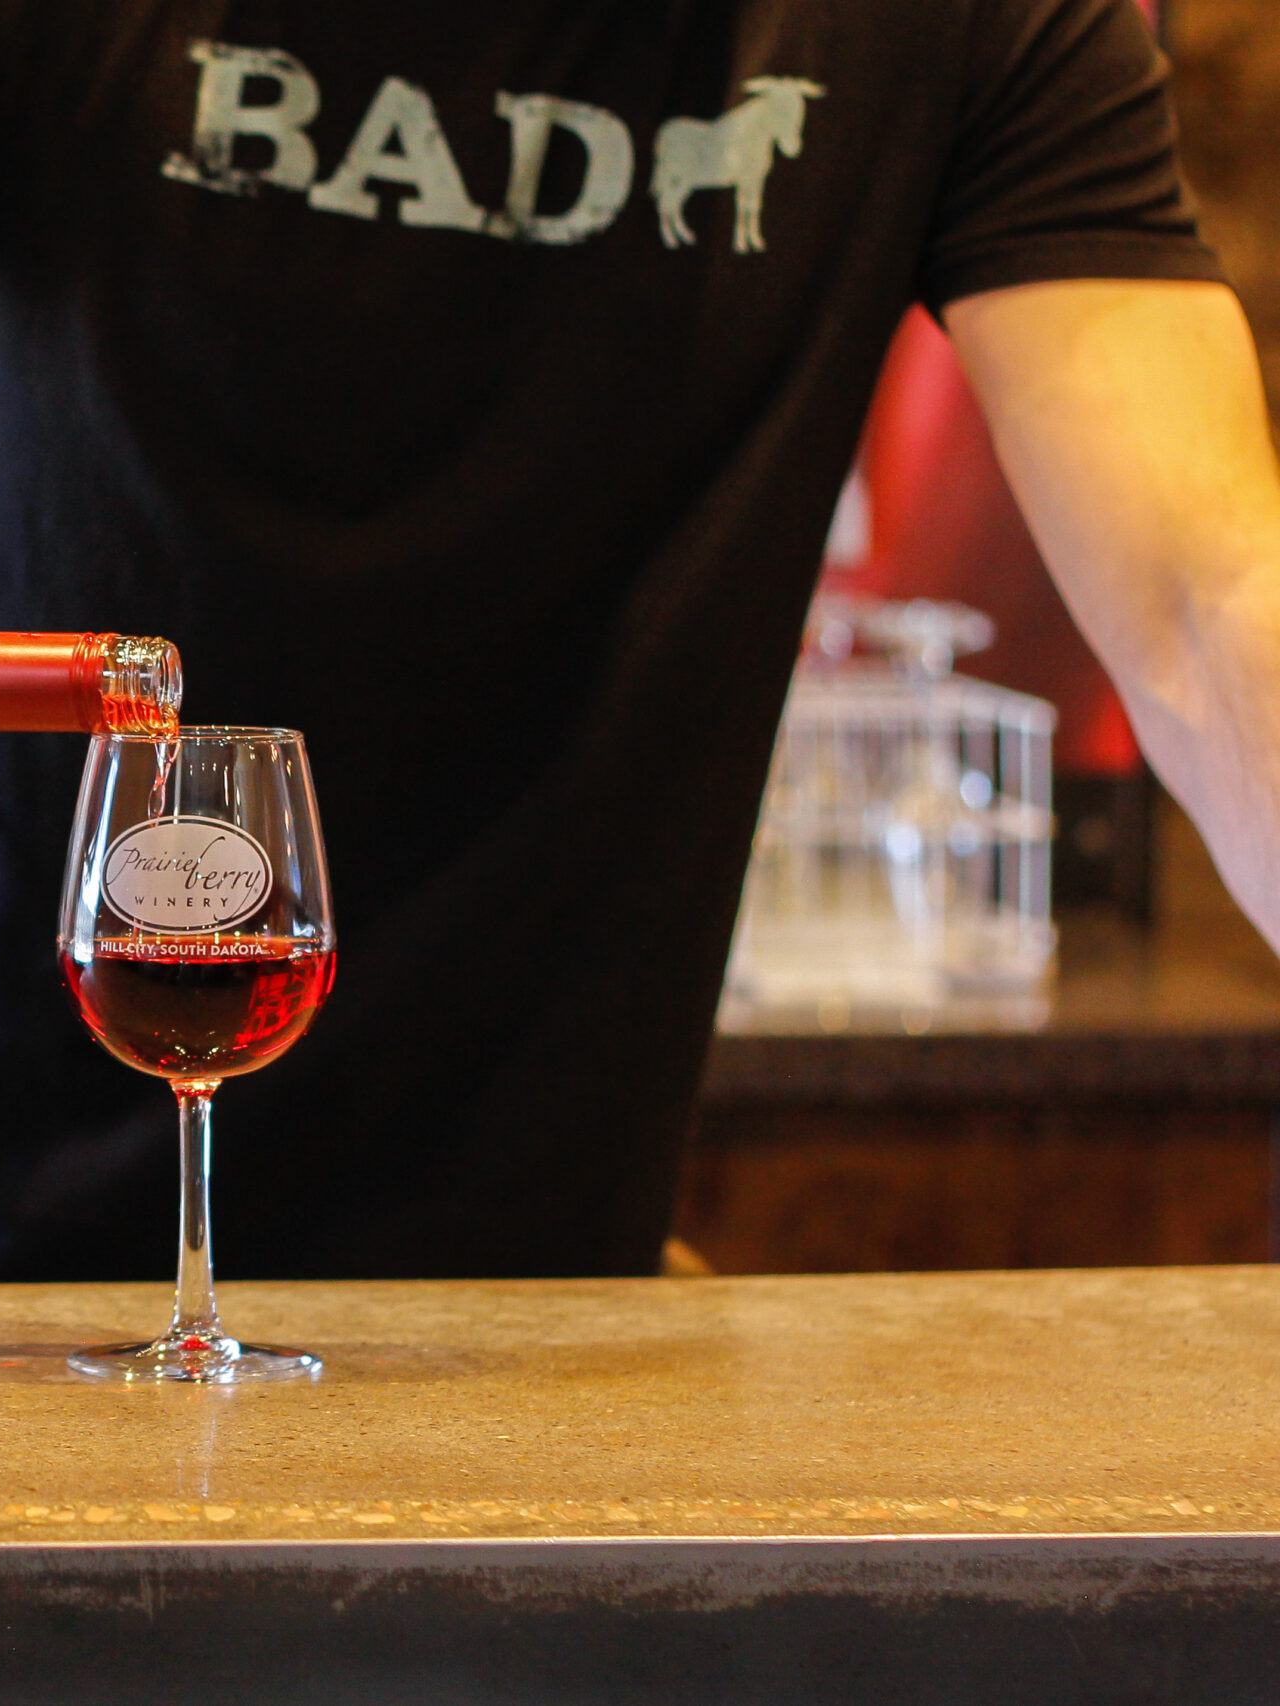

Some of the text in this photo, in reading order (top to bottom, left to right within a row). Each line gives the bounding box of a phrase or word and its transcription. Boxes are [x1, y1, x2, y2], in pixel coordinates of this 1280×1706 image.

[161, 38, 635, 245] BAD
[135, 896, 229, 908] WINERY
[101, 941, 263, 956] HILL CITY, SOUTH DAKOTA
